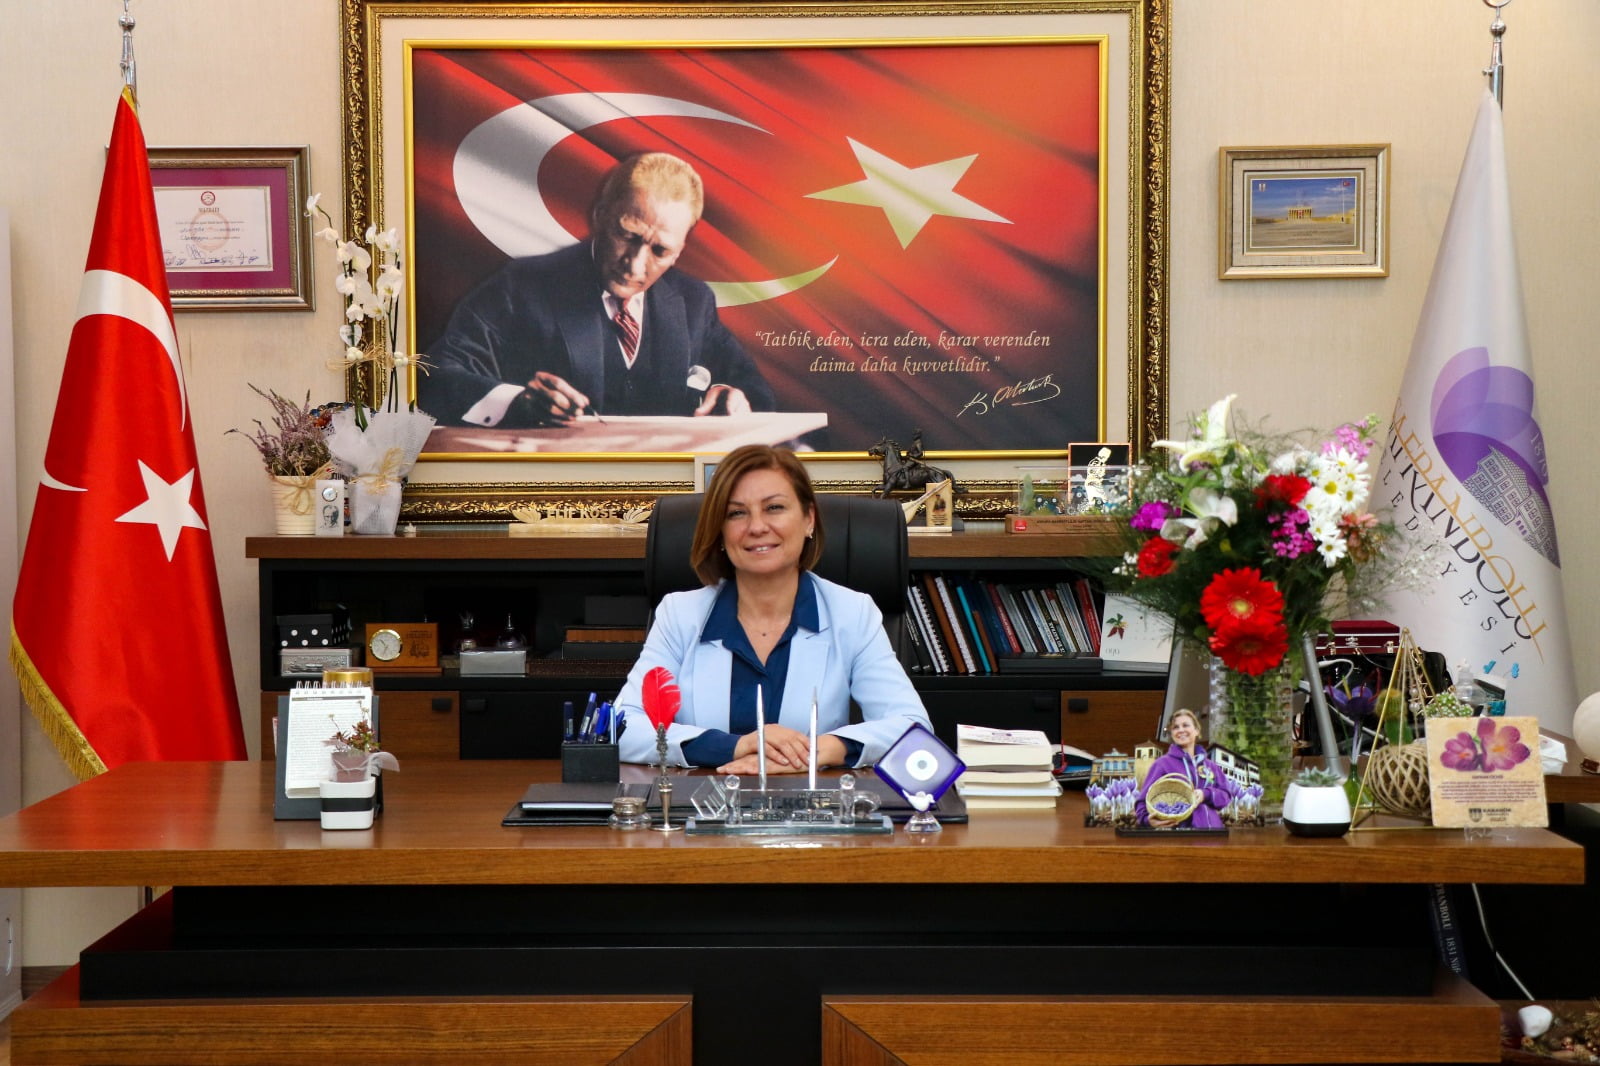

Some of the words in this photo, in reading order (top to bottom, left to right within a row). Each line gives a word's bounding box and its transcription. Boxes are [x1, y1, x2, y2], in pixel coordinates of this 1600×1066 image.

[816, 331, 854, 349] eden,
[860, 332, 888, 347] icra
[893, 331, 931, 349] eden,
[937, 331, 979, 347] karar
[983, 331, 1051, 347] verenden
[809, 356, 855, 373] daima
[860, 356, 897, 373] daha
